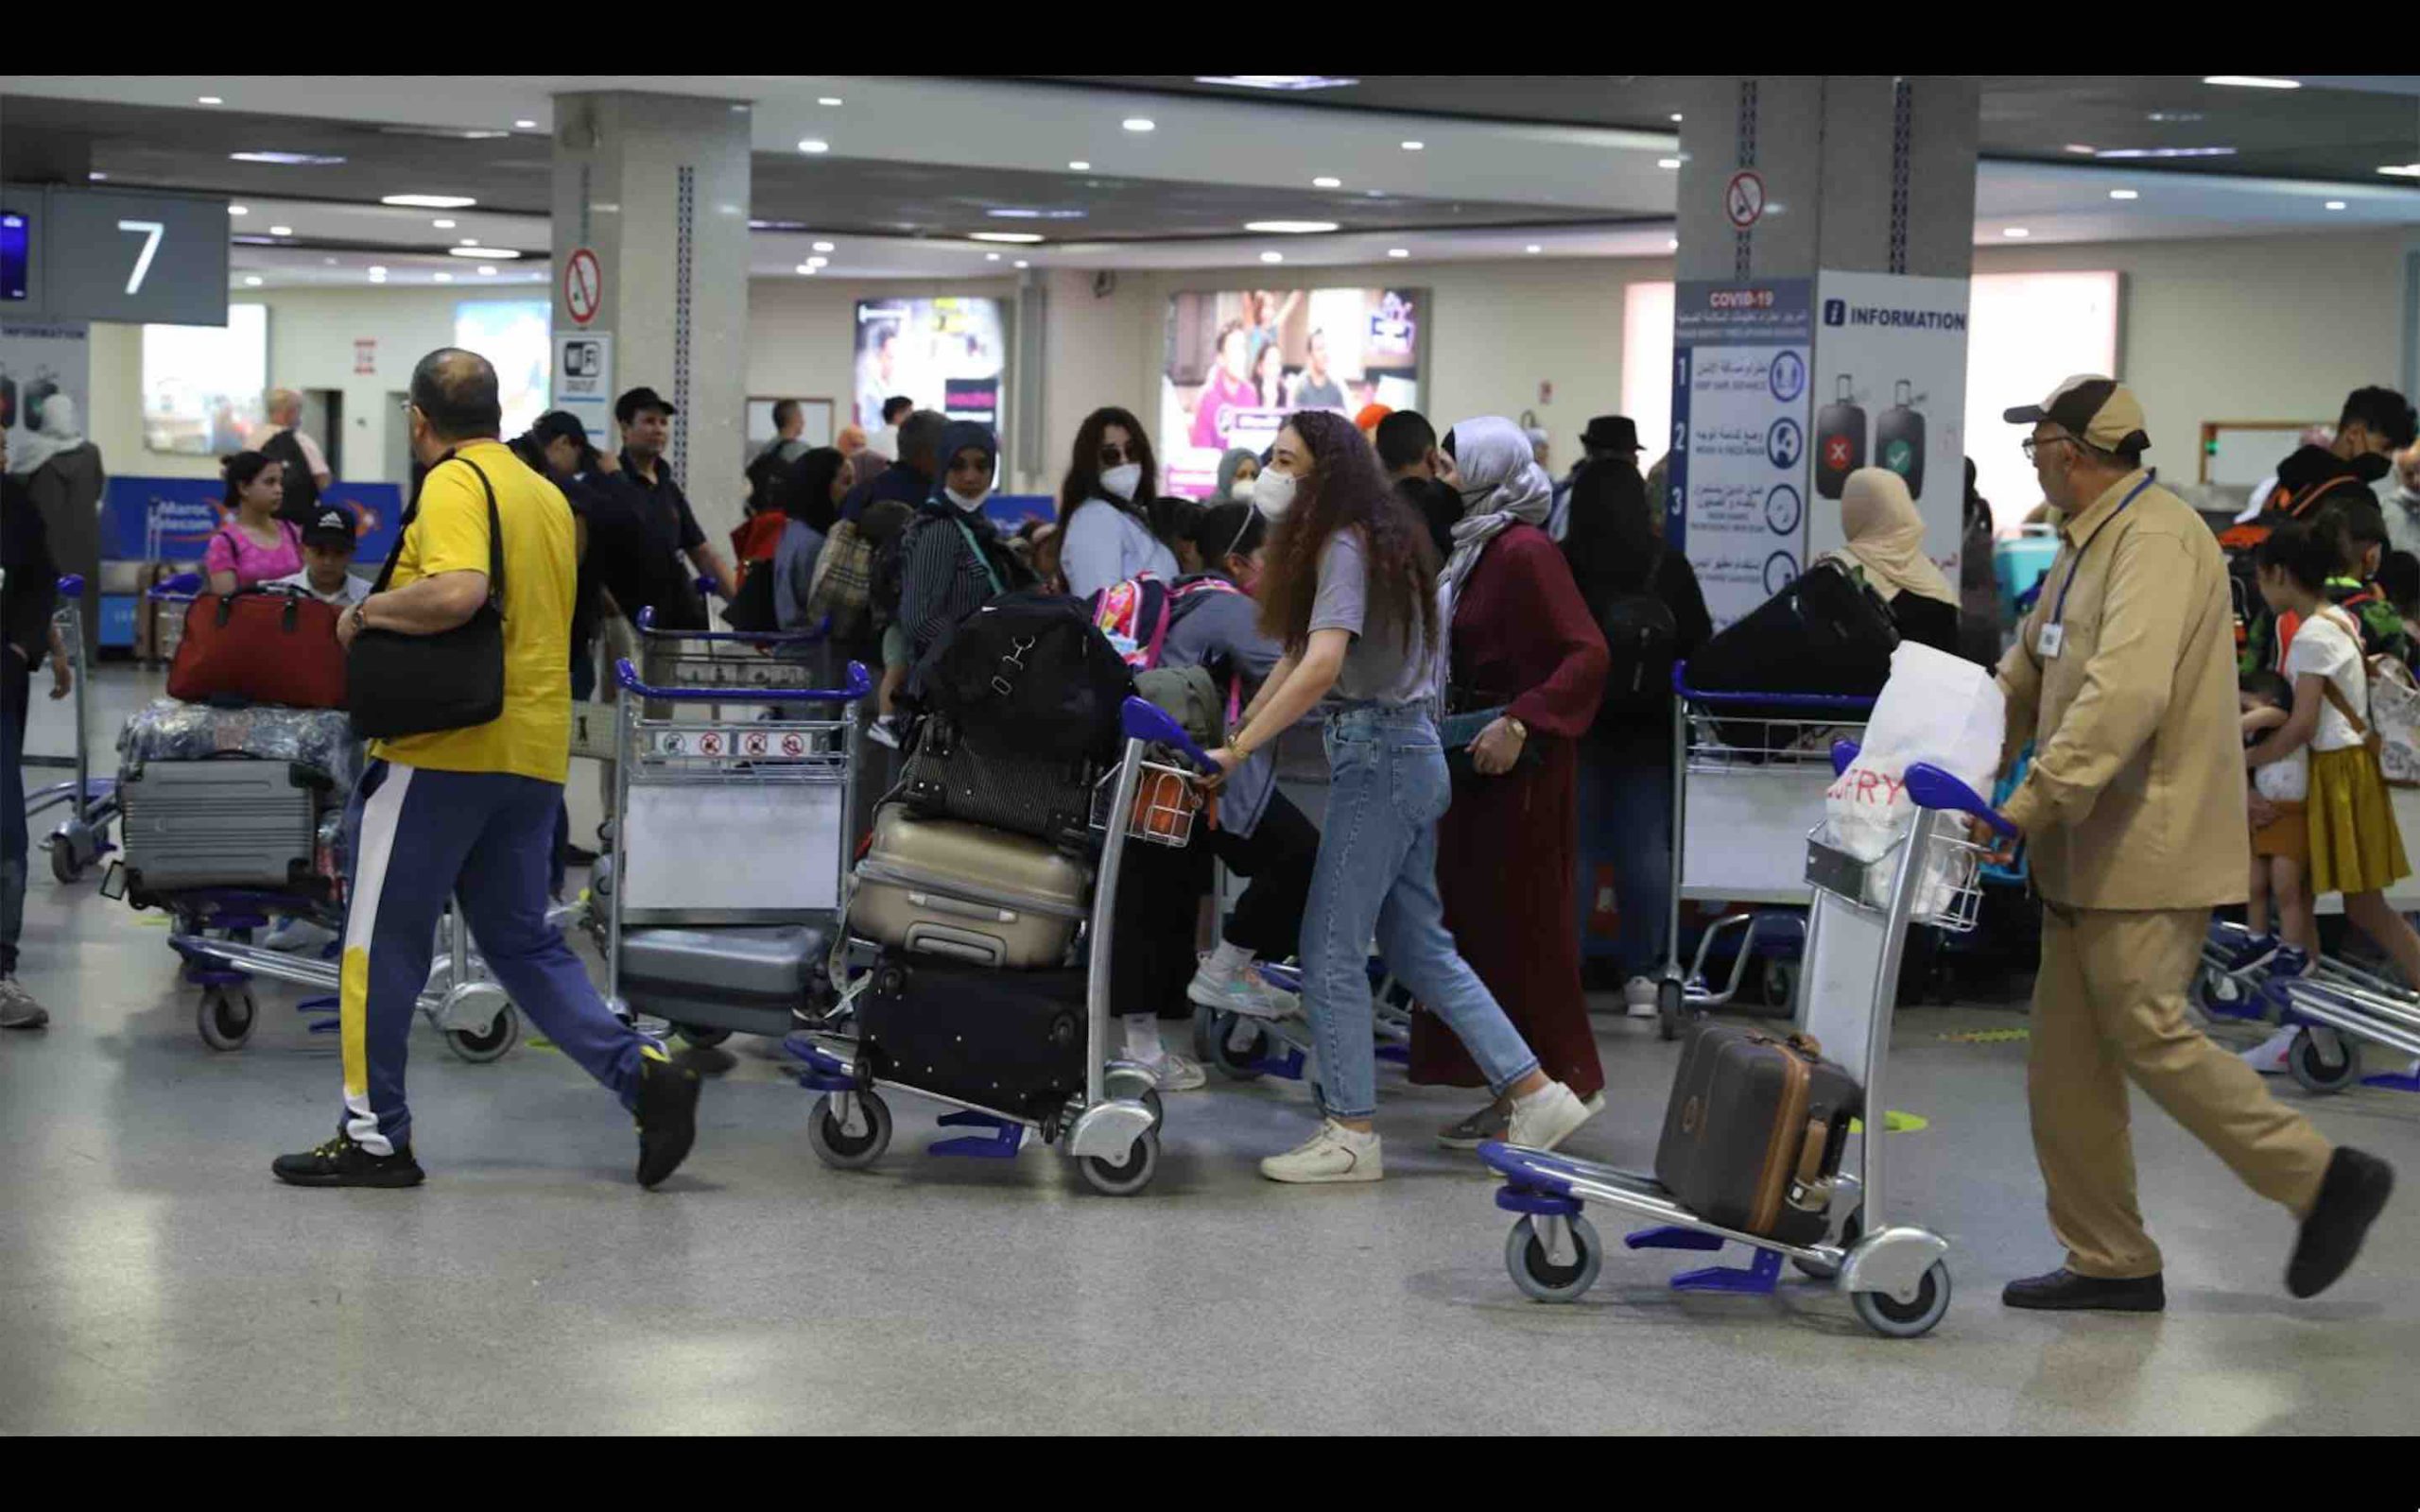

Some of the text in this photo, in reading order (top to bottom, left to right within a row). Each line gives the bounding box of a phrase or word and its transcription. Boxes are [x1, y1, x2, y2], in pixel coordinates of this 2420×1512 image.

[117, 219, 164, 295] 7
[1709, 290, 1774, 307] COVID-19
[1850, 307, 1966, 330] INFORMATION
[1677, 357, 1686, 387] 1
[1674, 422, 1685, 451] 2
[1671, 487, 1682, 516] 3
